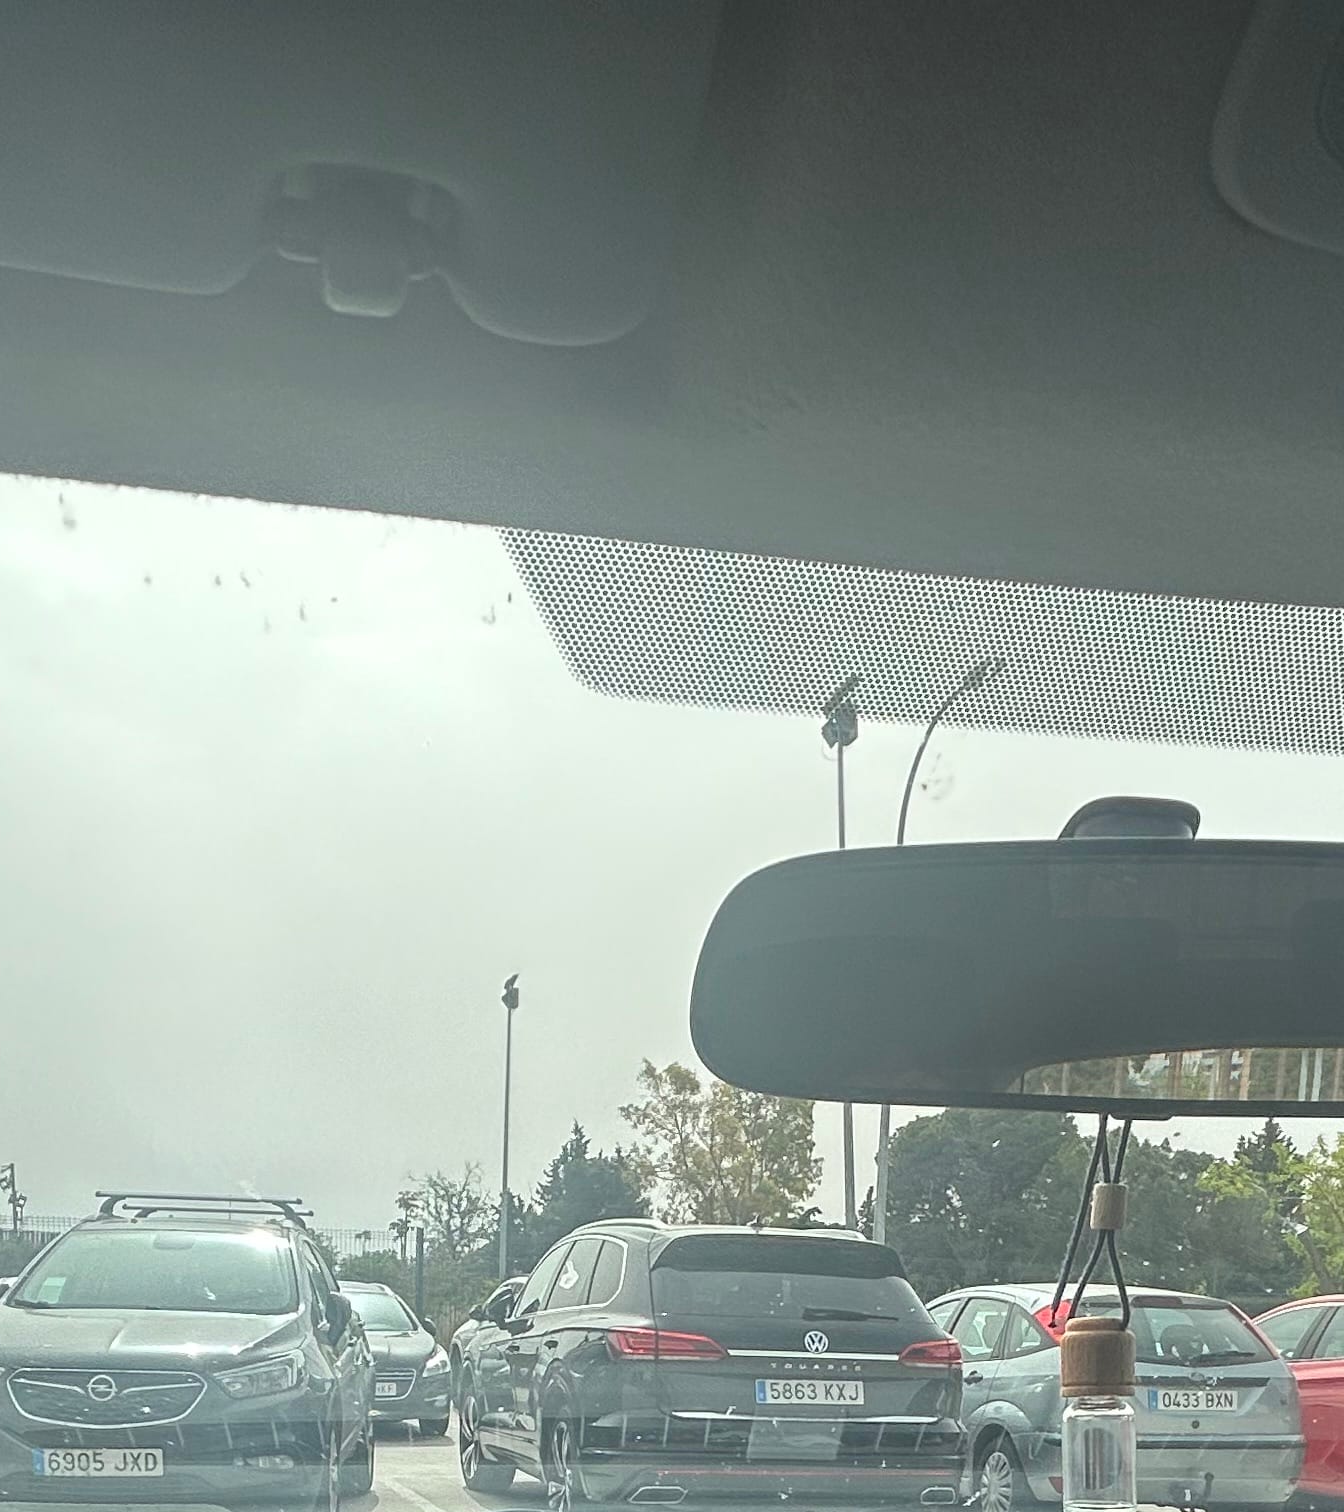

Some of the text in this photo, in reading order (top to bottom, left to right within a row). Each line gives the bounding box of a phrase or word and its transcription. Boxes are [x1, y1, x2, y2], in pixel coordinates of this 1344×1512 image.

[769, 1383, 859, 1401] 5863 KXJ
[1162, 1392, 1234, 1408] 0433 BXN
[48, 1452, 158, 1472] 6905 JXD
